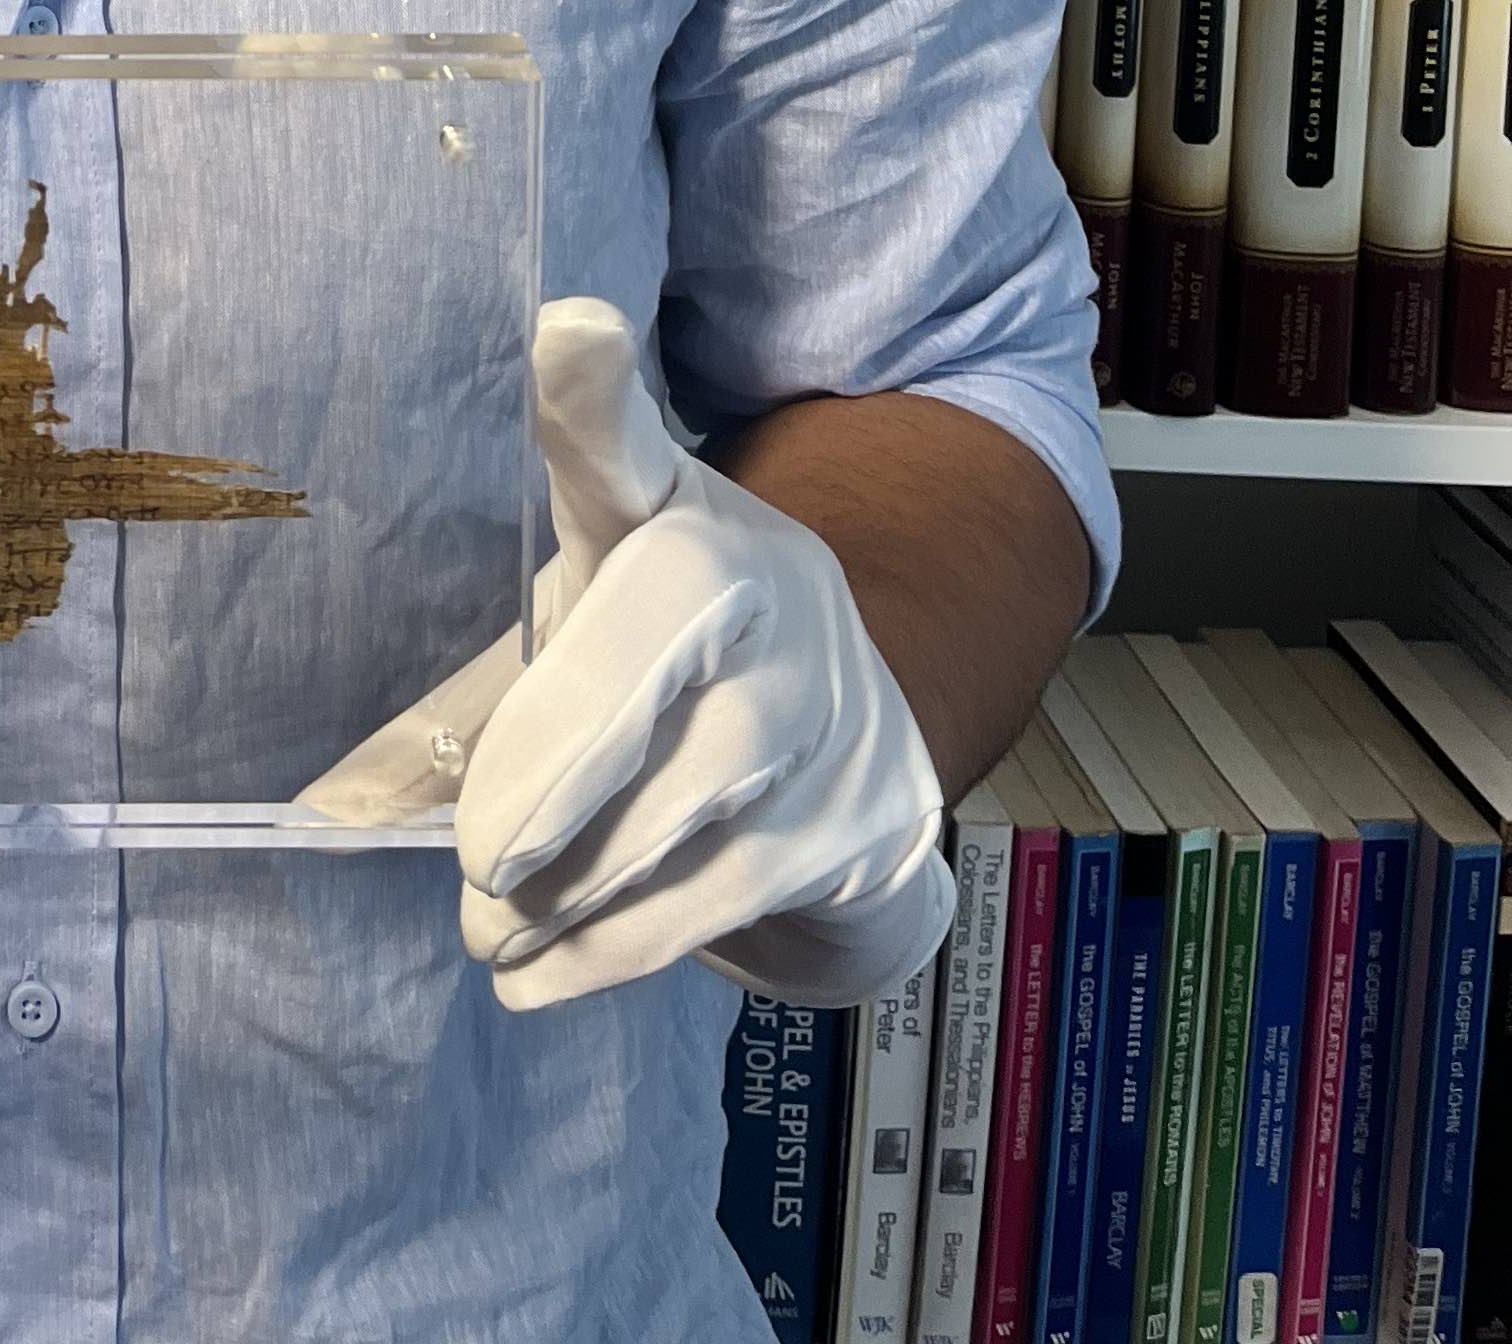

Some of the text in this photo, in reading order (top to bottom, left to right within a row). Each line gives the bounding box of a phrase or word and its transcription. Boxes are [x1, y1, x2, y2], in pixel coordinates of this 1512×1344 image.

[742, 1034, 776, 1116] JOHN
[876, 999, 899, 1053] Peter
[1069, 944, 1096, 1133] the GOSPEL of JOHN
[772, 1103, 808, 1228] EPISTLES
